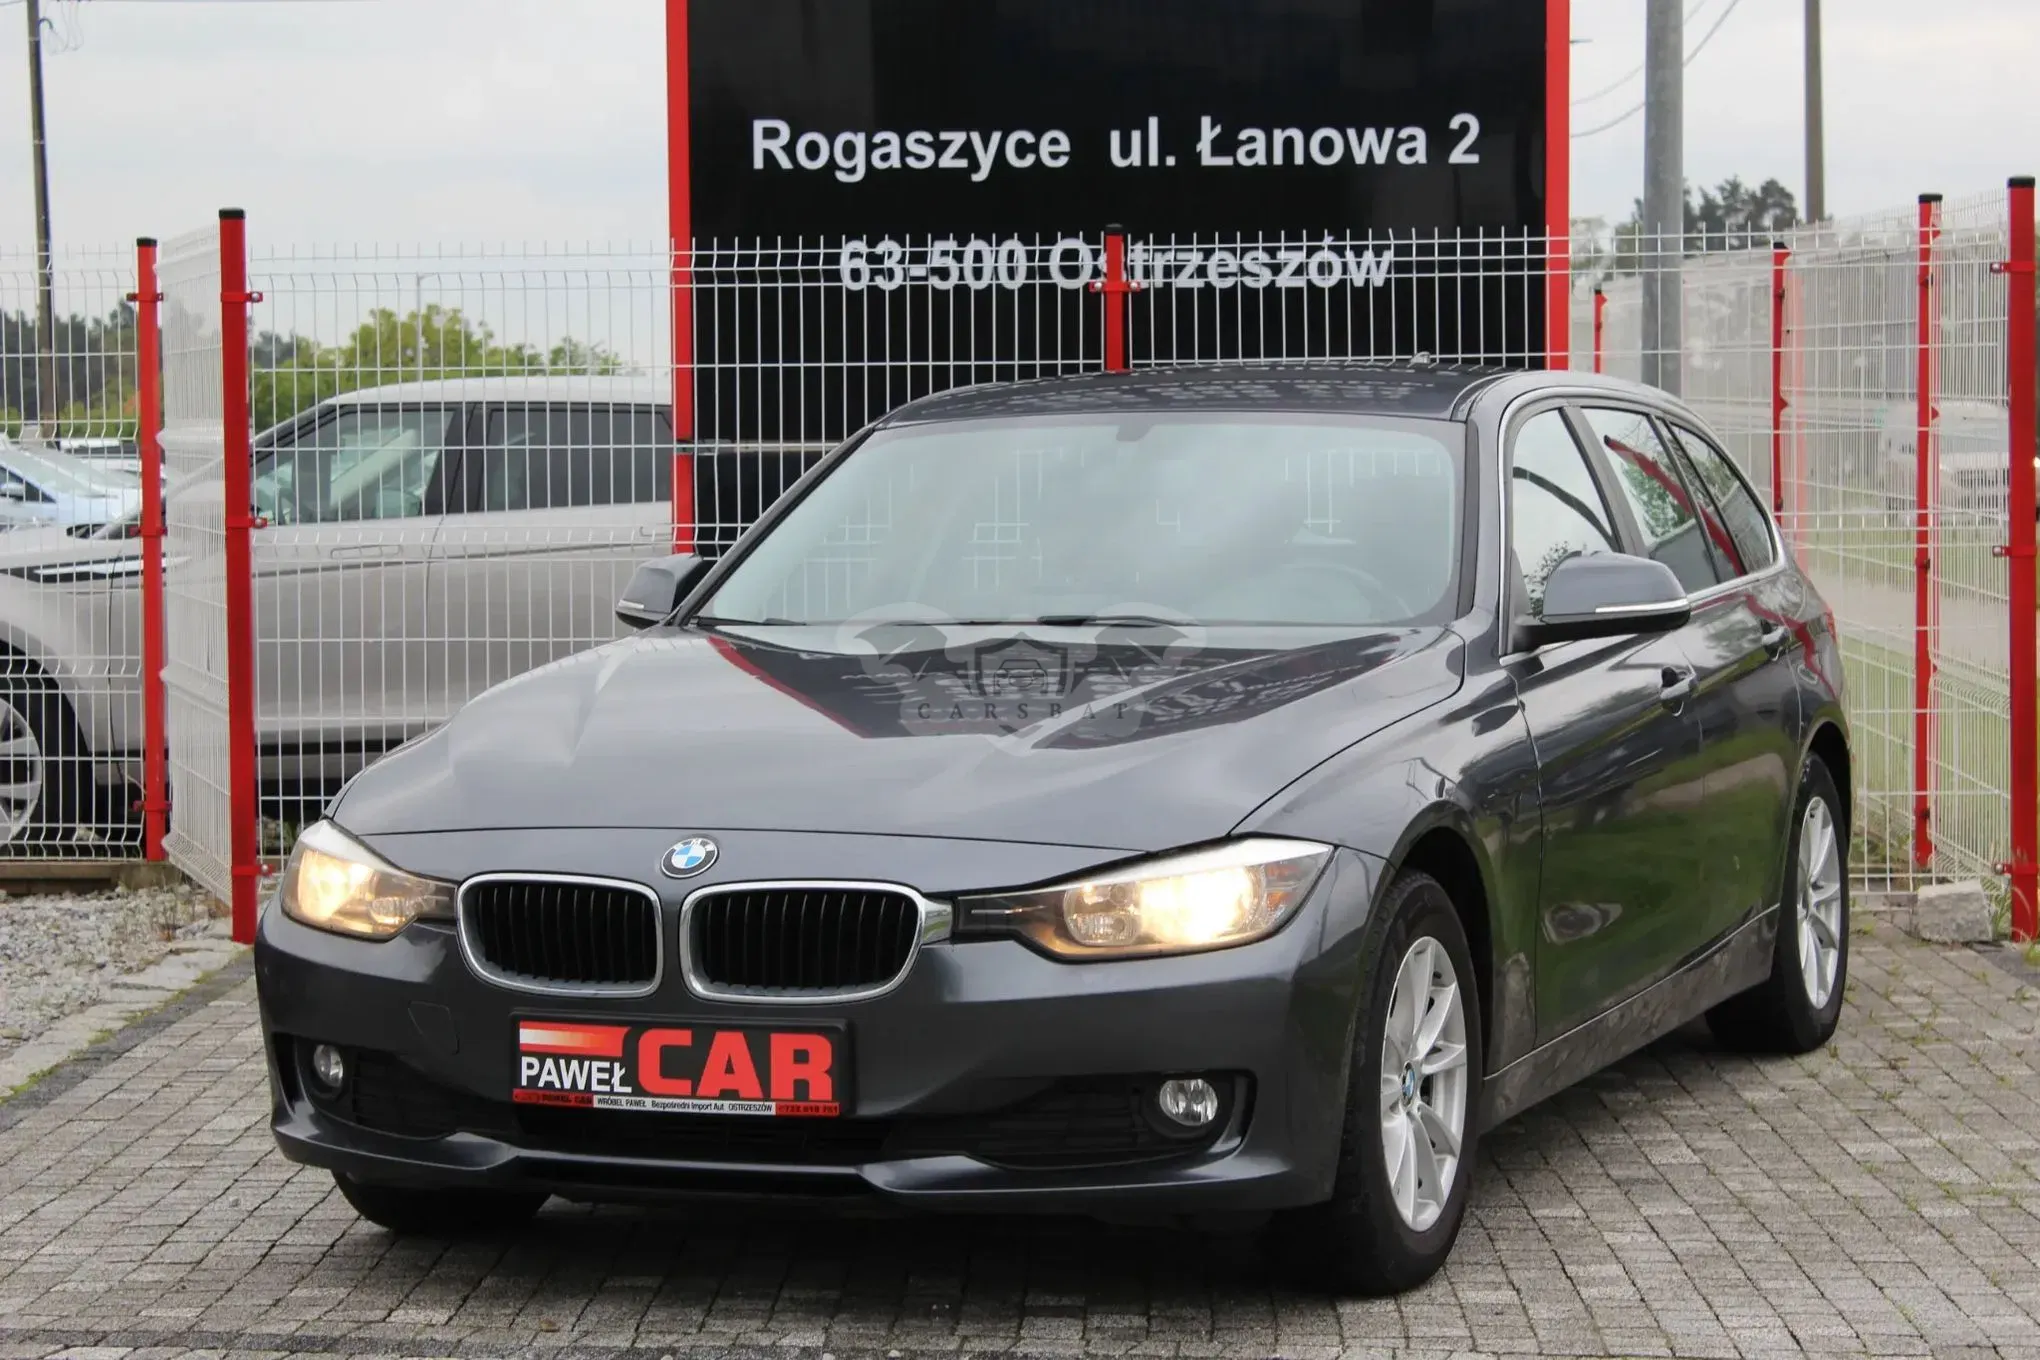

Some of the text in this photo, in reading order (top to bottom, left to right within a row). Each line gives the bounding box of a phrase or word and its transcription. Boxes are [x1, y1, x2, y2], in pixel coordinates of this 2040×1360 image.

[752, 112, 1481, 183] Rogaszyce ul. Łanowa 2
[840, 238, 1028, 291] 63-500
[520, 1027, 833, 1101] PAWEŁ CAR
[651, 1099, 690, 1111] Bezpośredni
[691, 1101, 713, 1112] Import
[728, 1101, 772, 1112] OSTRZESZÓW
